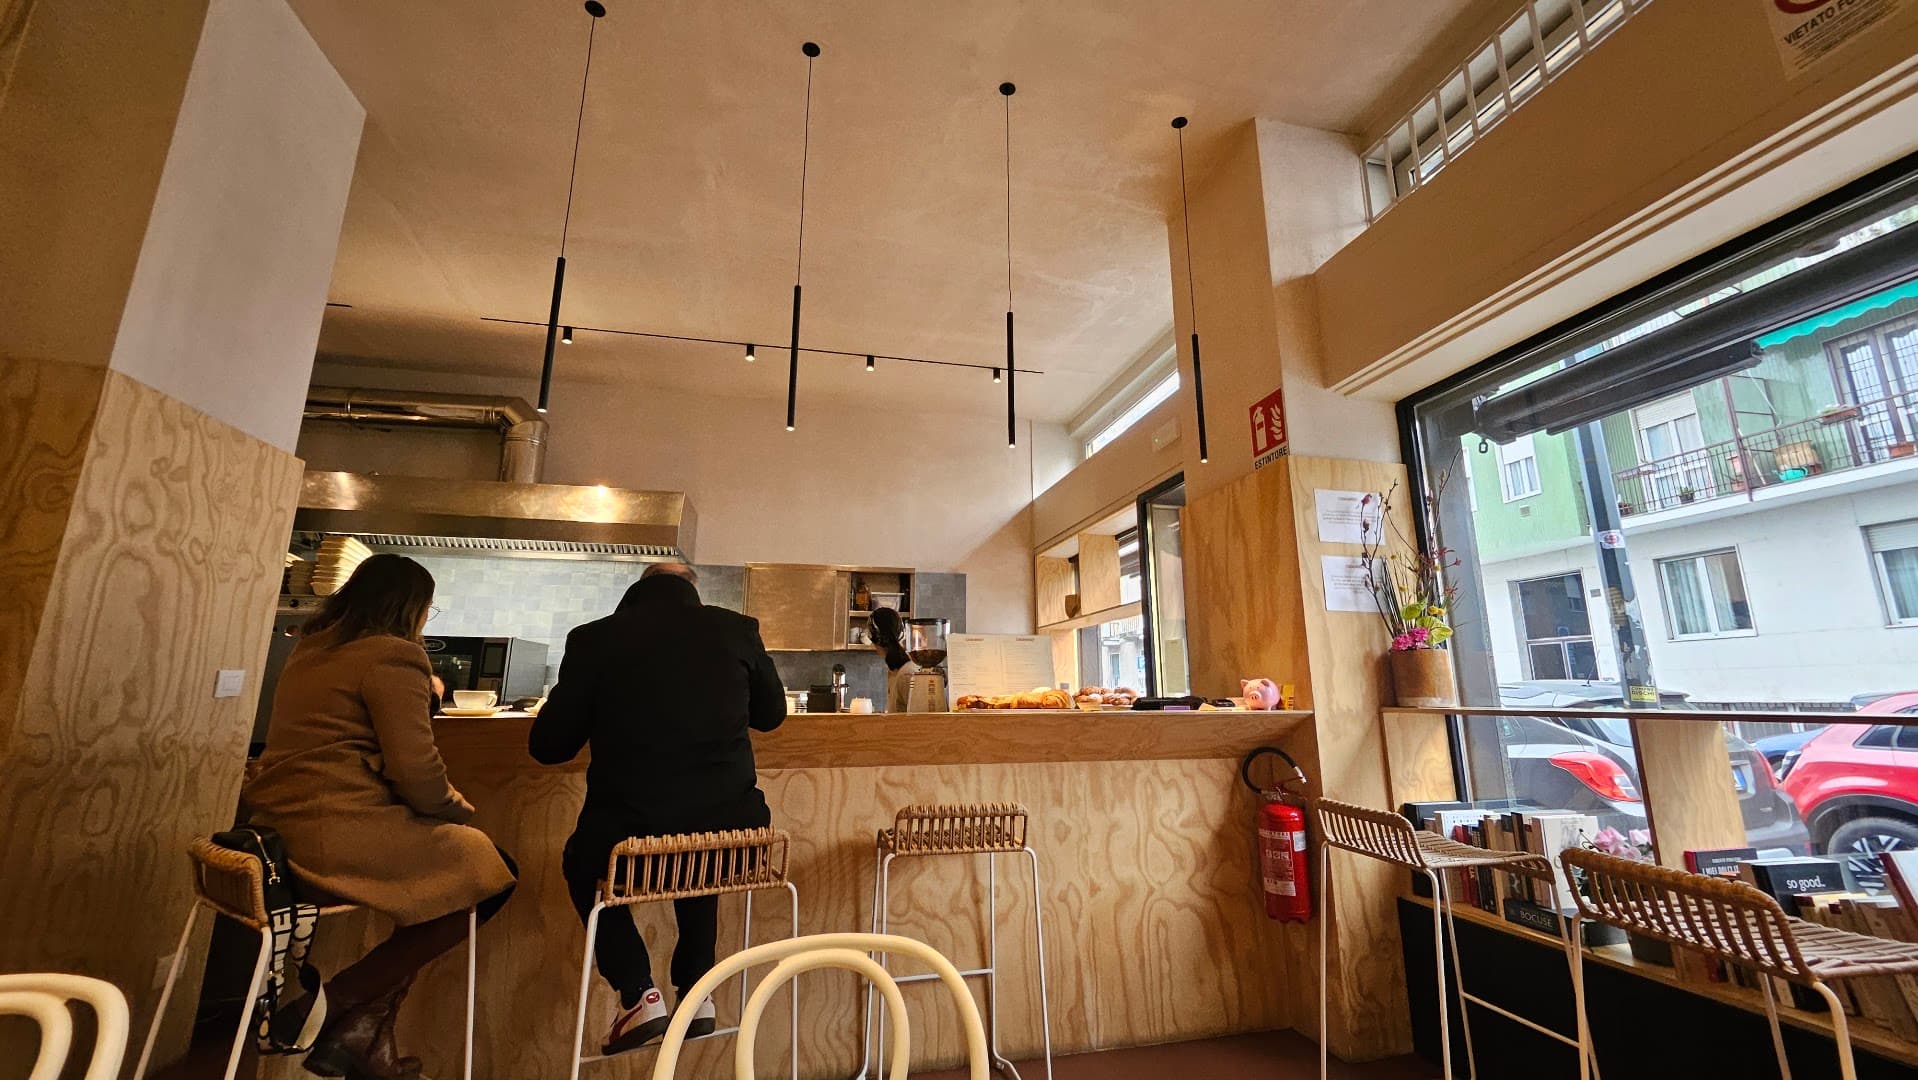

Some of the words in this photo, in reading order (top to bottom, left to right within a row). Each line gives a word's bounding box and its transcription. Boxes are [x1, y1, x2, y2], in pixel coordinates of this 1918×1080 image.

[1784, 6, 1835, 44] VIETATO
[1254, 445, 1288, 470] ESTINTORE
[1786, 879, 1798, 889] so
[1519, 910, 1554, 929] BOCUSE
